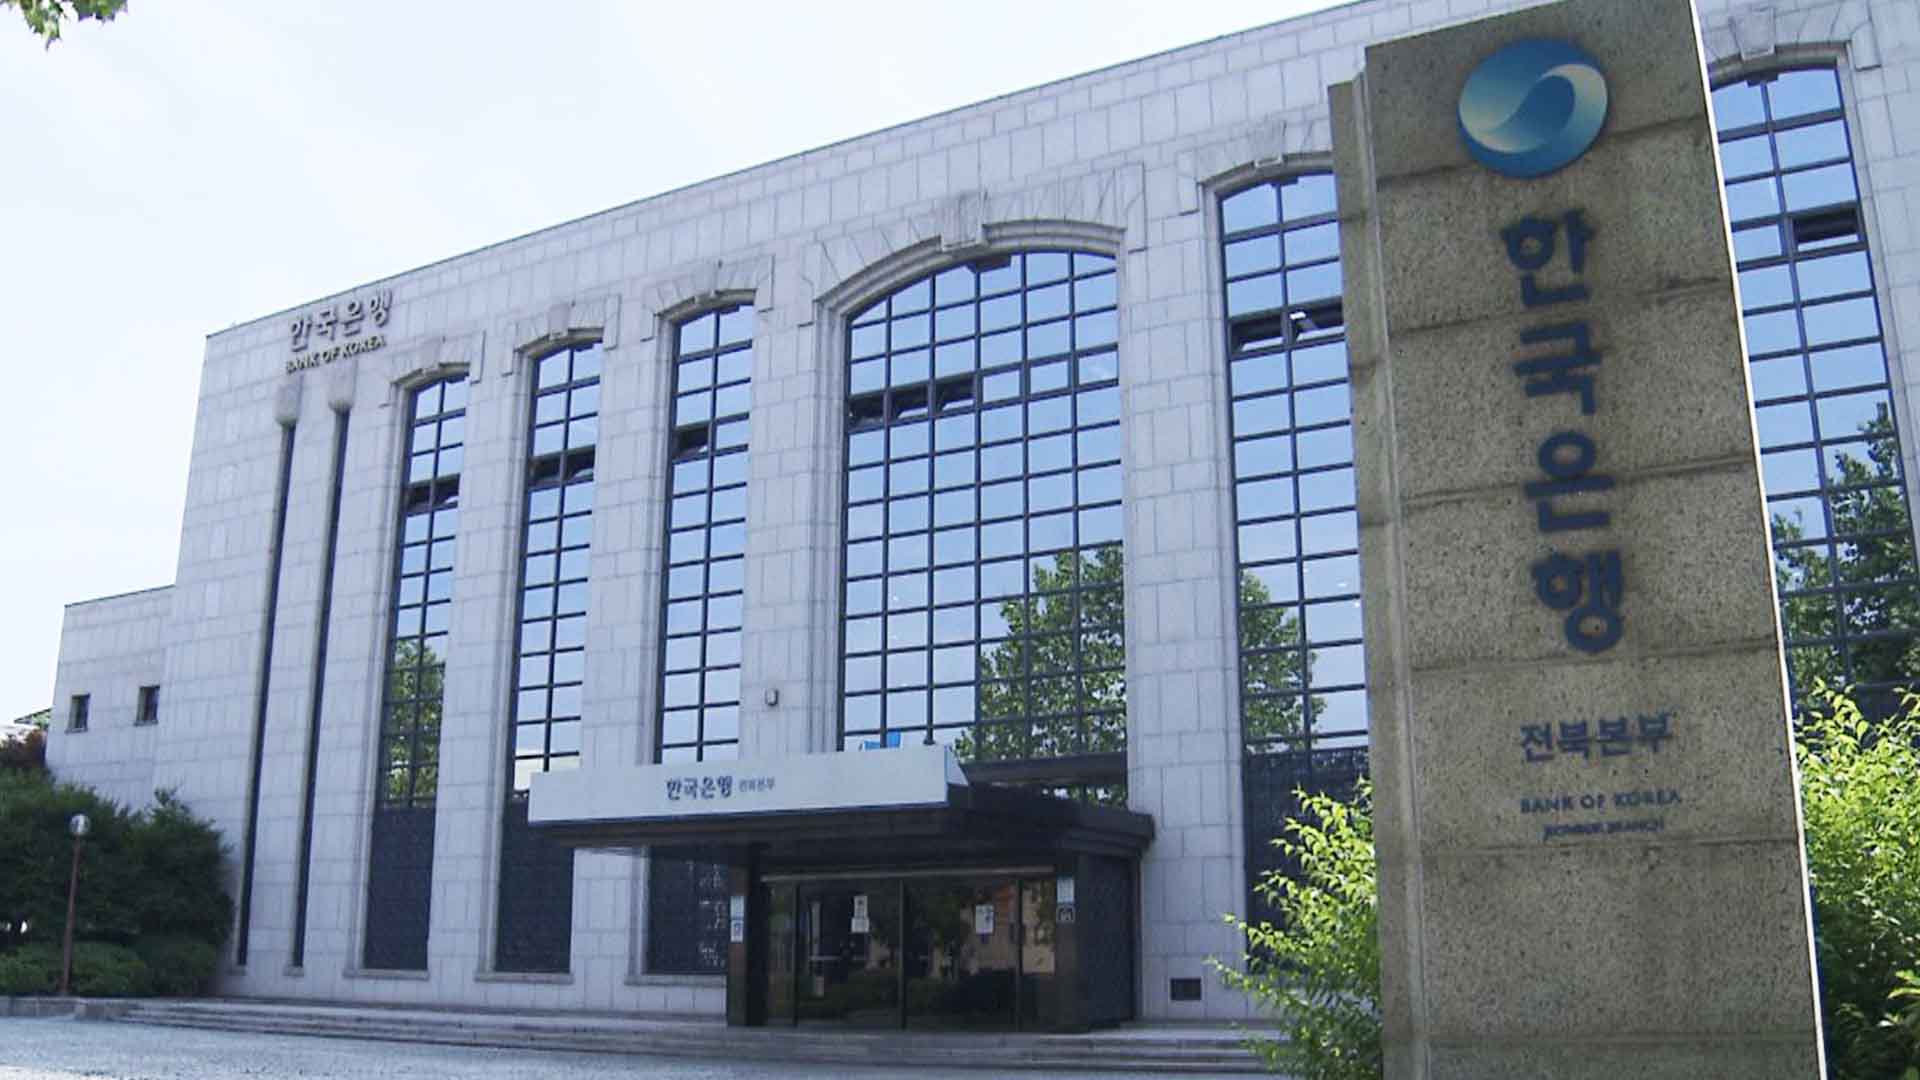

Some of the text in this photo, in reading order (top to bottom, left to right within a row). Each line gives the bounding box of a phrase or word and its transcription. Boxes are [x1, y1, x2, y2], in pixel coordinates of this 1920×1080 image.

[290, 288, 393, 352] 한국은행
[286, 334, 387, 375] BANK OF KOREA
[1501, 206, 1626, 655] 한국은행
[1519, 711, 1675, 763] 전북본부
[666, 775, 734, 800] 한국은행
[1520, 788, 1683, 814] BANK OF KOREA
